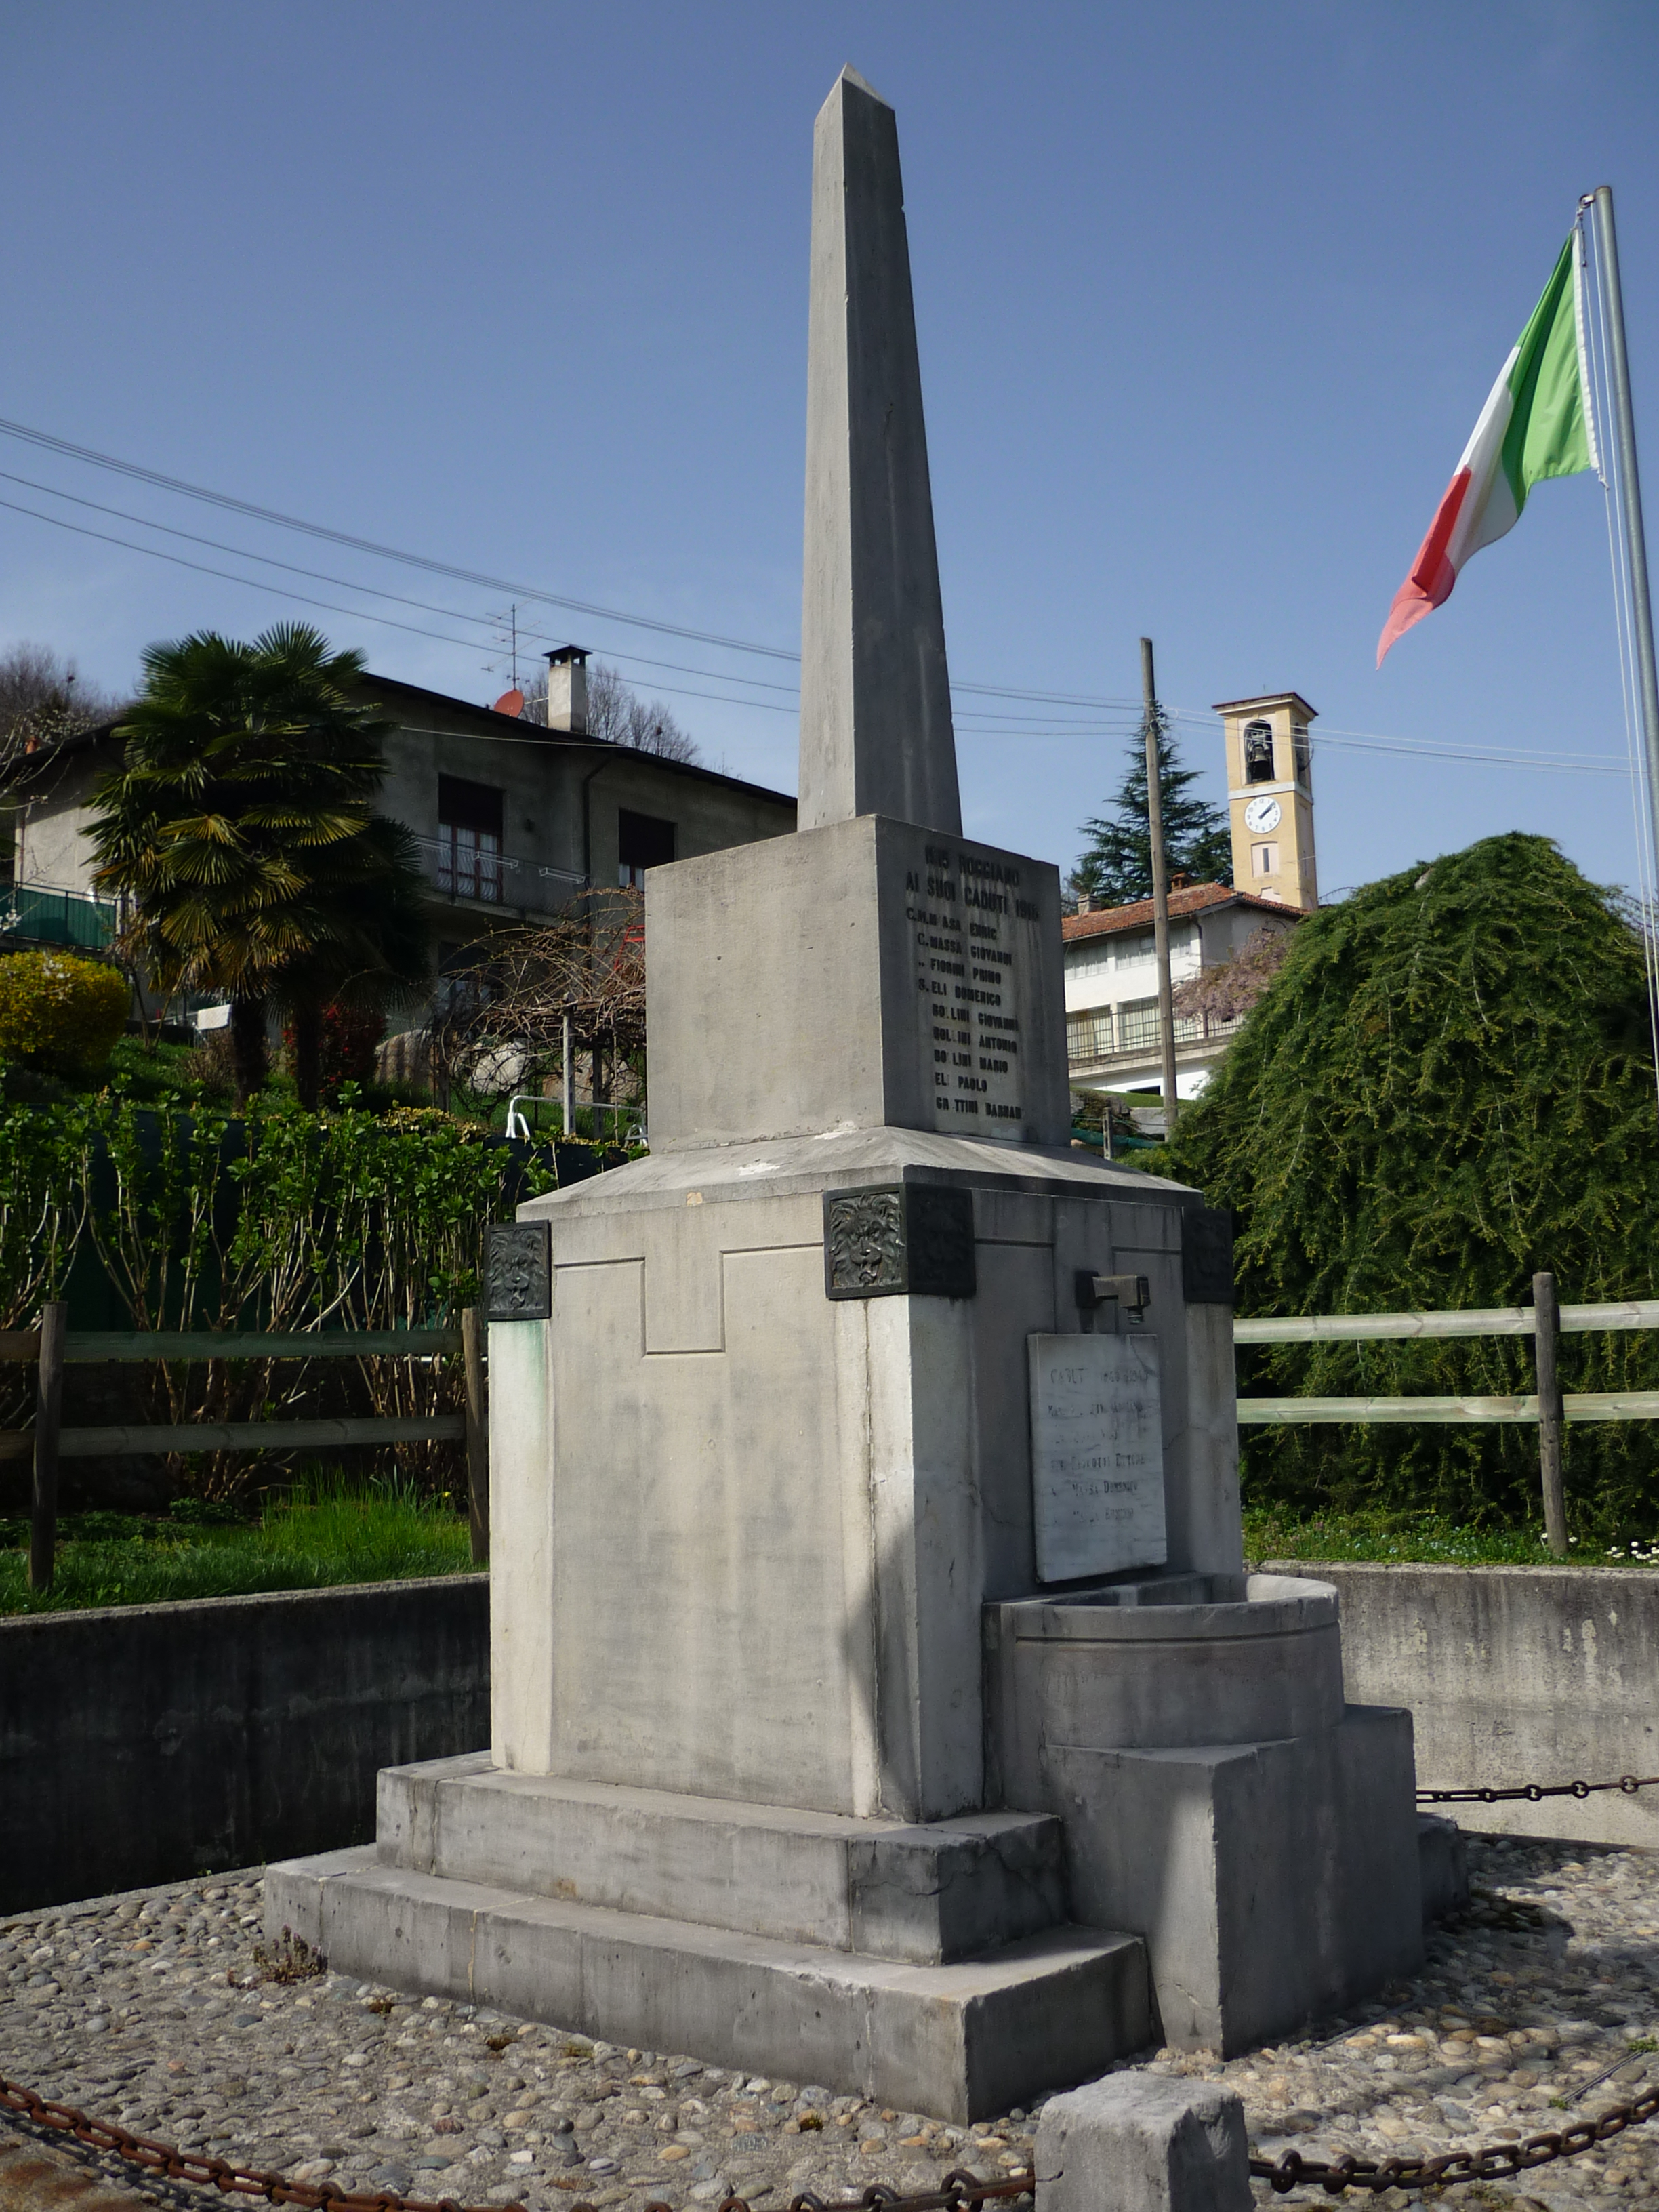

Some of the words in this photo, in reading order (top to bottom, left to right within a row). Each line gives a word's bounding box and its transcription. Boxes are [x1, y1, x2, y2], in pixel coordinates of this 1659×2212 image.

[906, 871, 919, 893] AI
[927, 876, 956, 902] SUOI
[964, 886, 1007, 914] CADUTI
[970, 945, 1012, 966] GIOVANNI
[972, 967, 1002, 985] PRIMO
[954, 985, 1001, 1006] DOMENICO
[977, 1012, 1019, 1032] GIOVANNI
[979, 1034, 1018, 1054] ANTONIO
[979, 1057, 1008, 1074] MARIO
[958, 1076, 988, 1092] PAOLO
